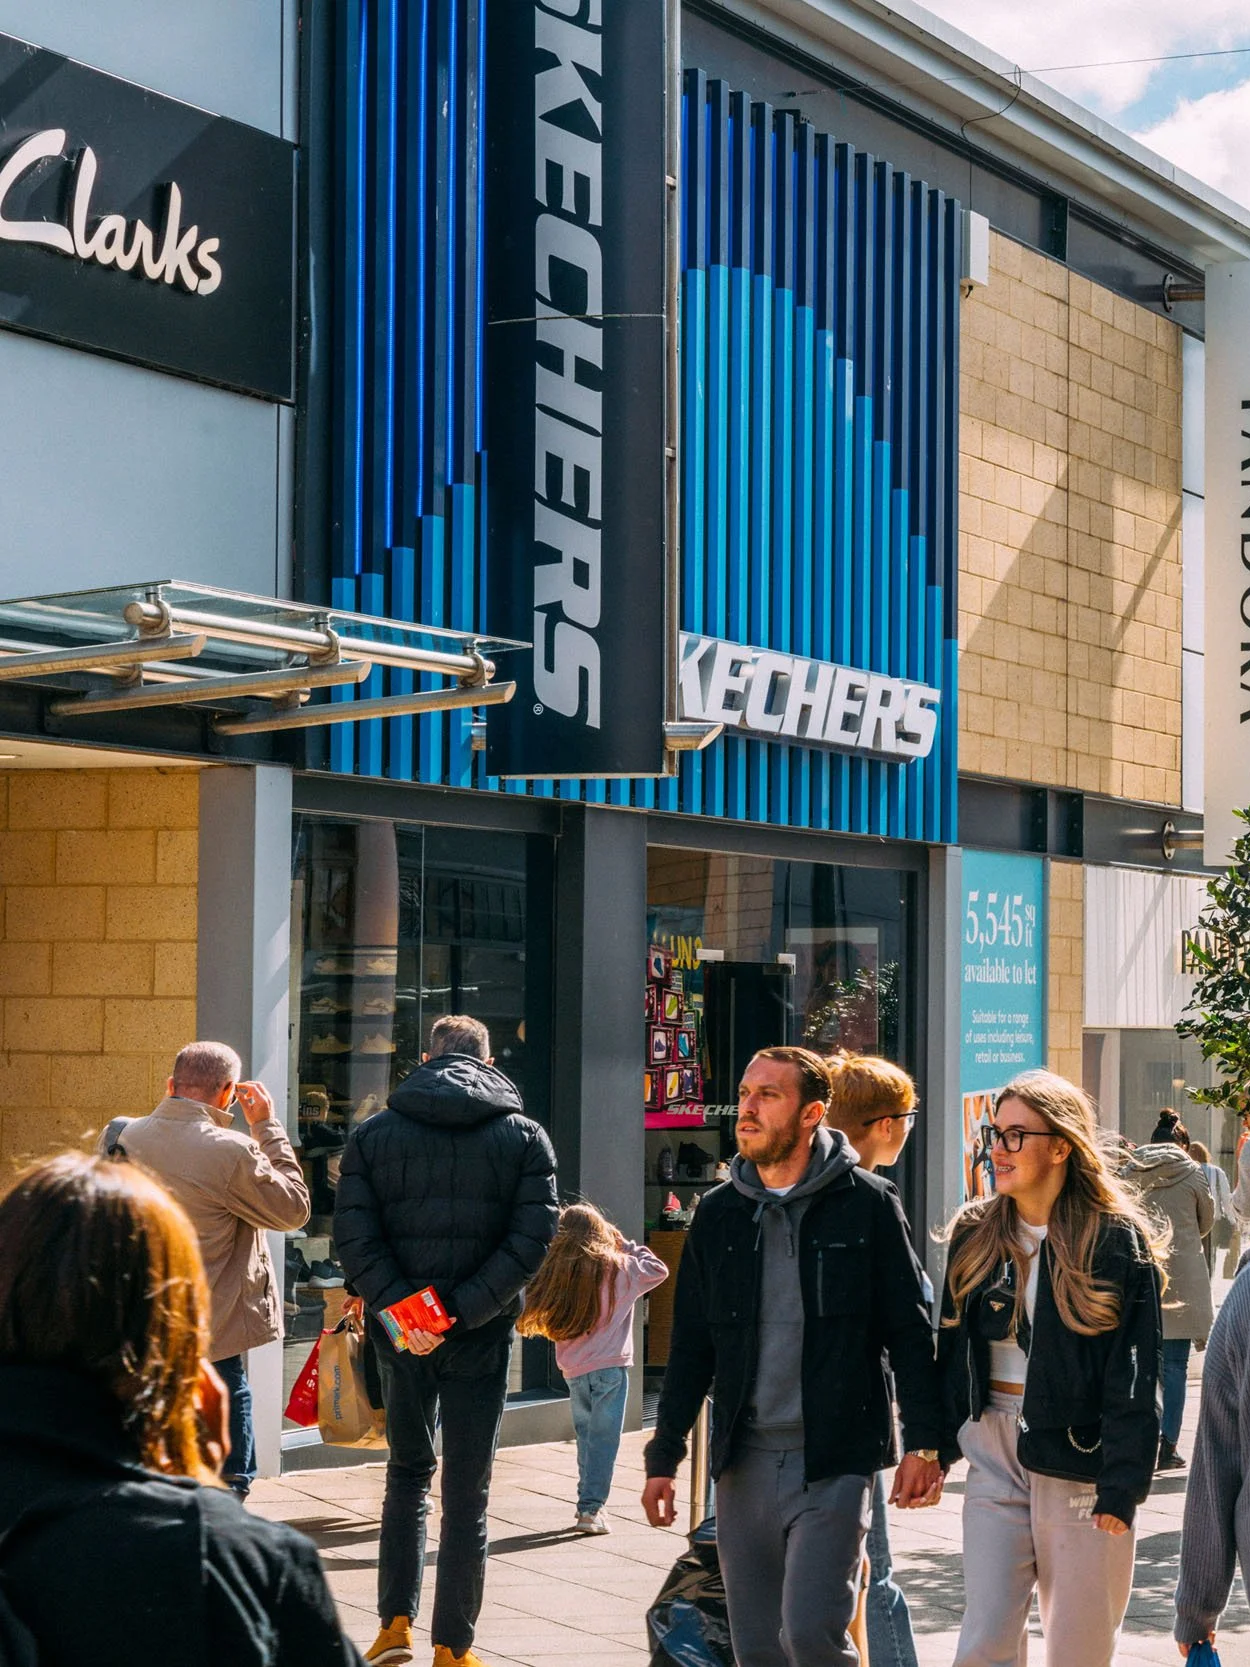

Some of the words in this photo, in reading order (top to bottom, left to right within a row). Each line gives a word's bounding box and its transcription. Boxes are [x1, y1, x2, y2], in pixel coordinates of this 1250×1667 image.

[0, 128, 222, 295] Clarks
[534, 0, 602, 729] KECHERS
[966, 890, 1023, 953] 5,545
[1025, 904, 1036, 927] sq
[1025, 923, 1033, 948] ft
[964, 957, 1010, 984] available
[1012, 962, 1023, 984] to
[1025, 960, 1037, 985] let
[972, 1009, 997, 1024] Suitable
[998, 1010, 1007, 1024] for
[1013, 1014, 1029, 1028] range
[965, 1030, 973, 1043] of
[973, 1033, 986, 1043] uses
[987, 1030, 1014, 1047] including
[975, 1049, 991, 1063] retail
[992, 1053, 999, 1063] or
[666, 1104, 740, 1116] SKECHE
[334, 1365, 342, 1420] primark.com
